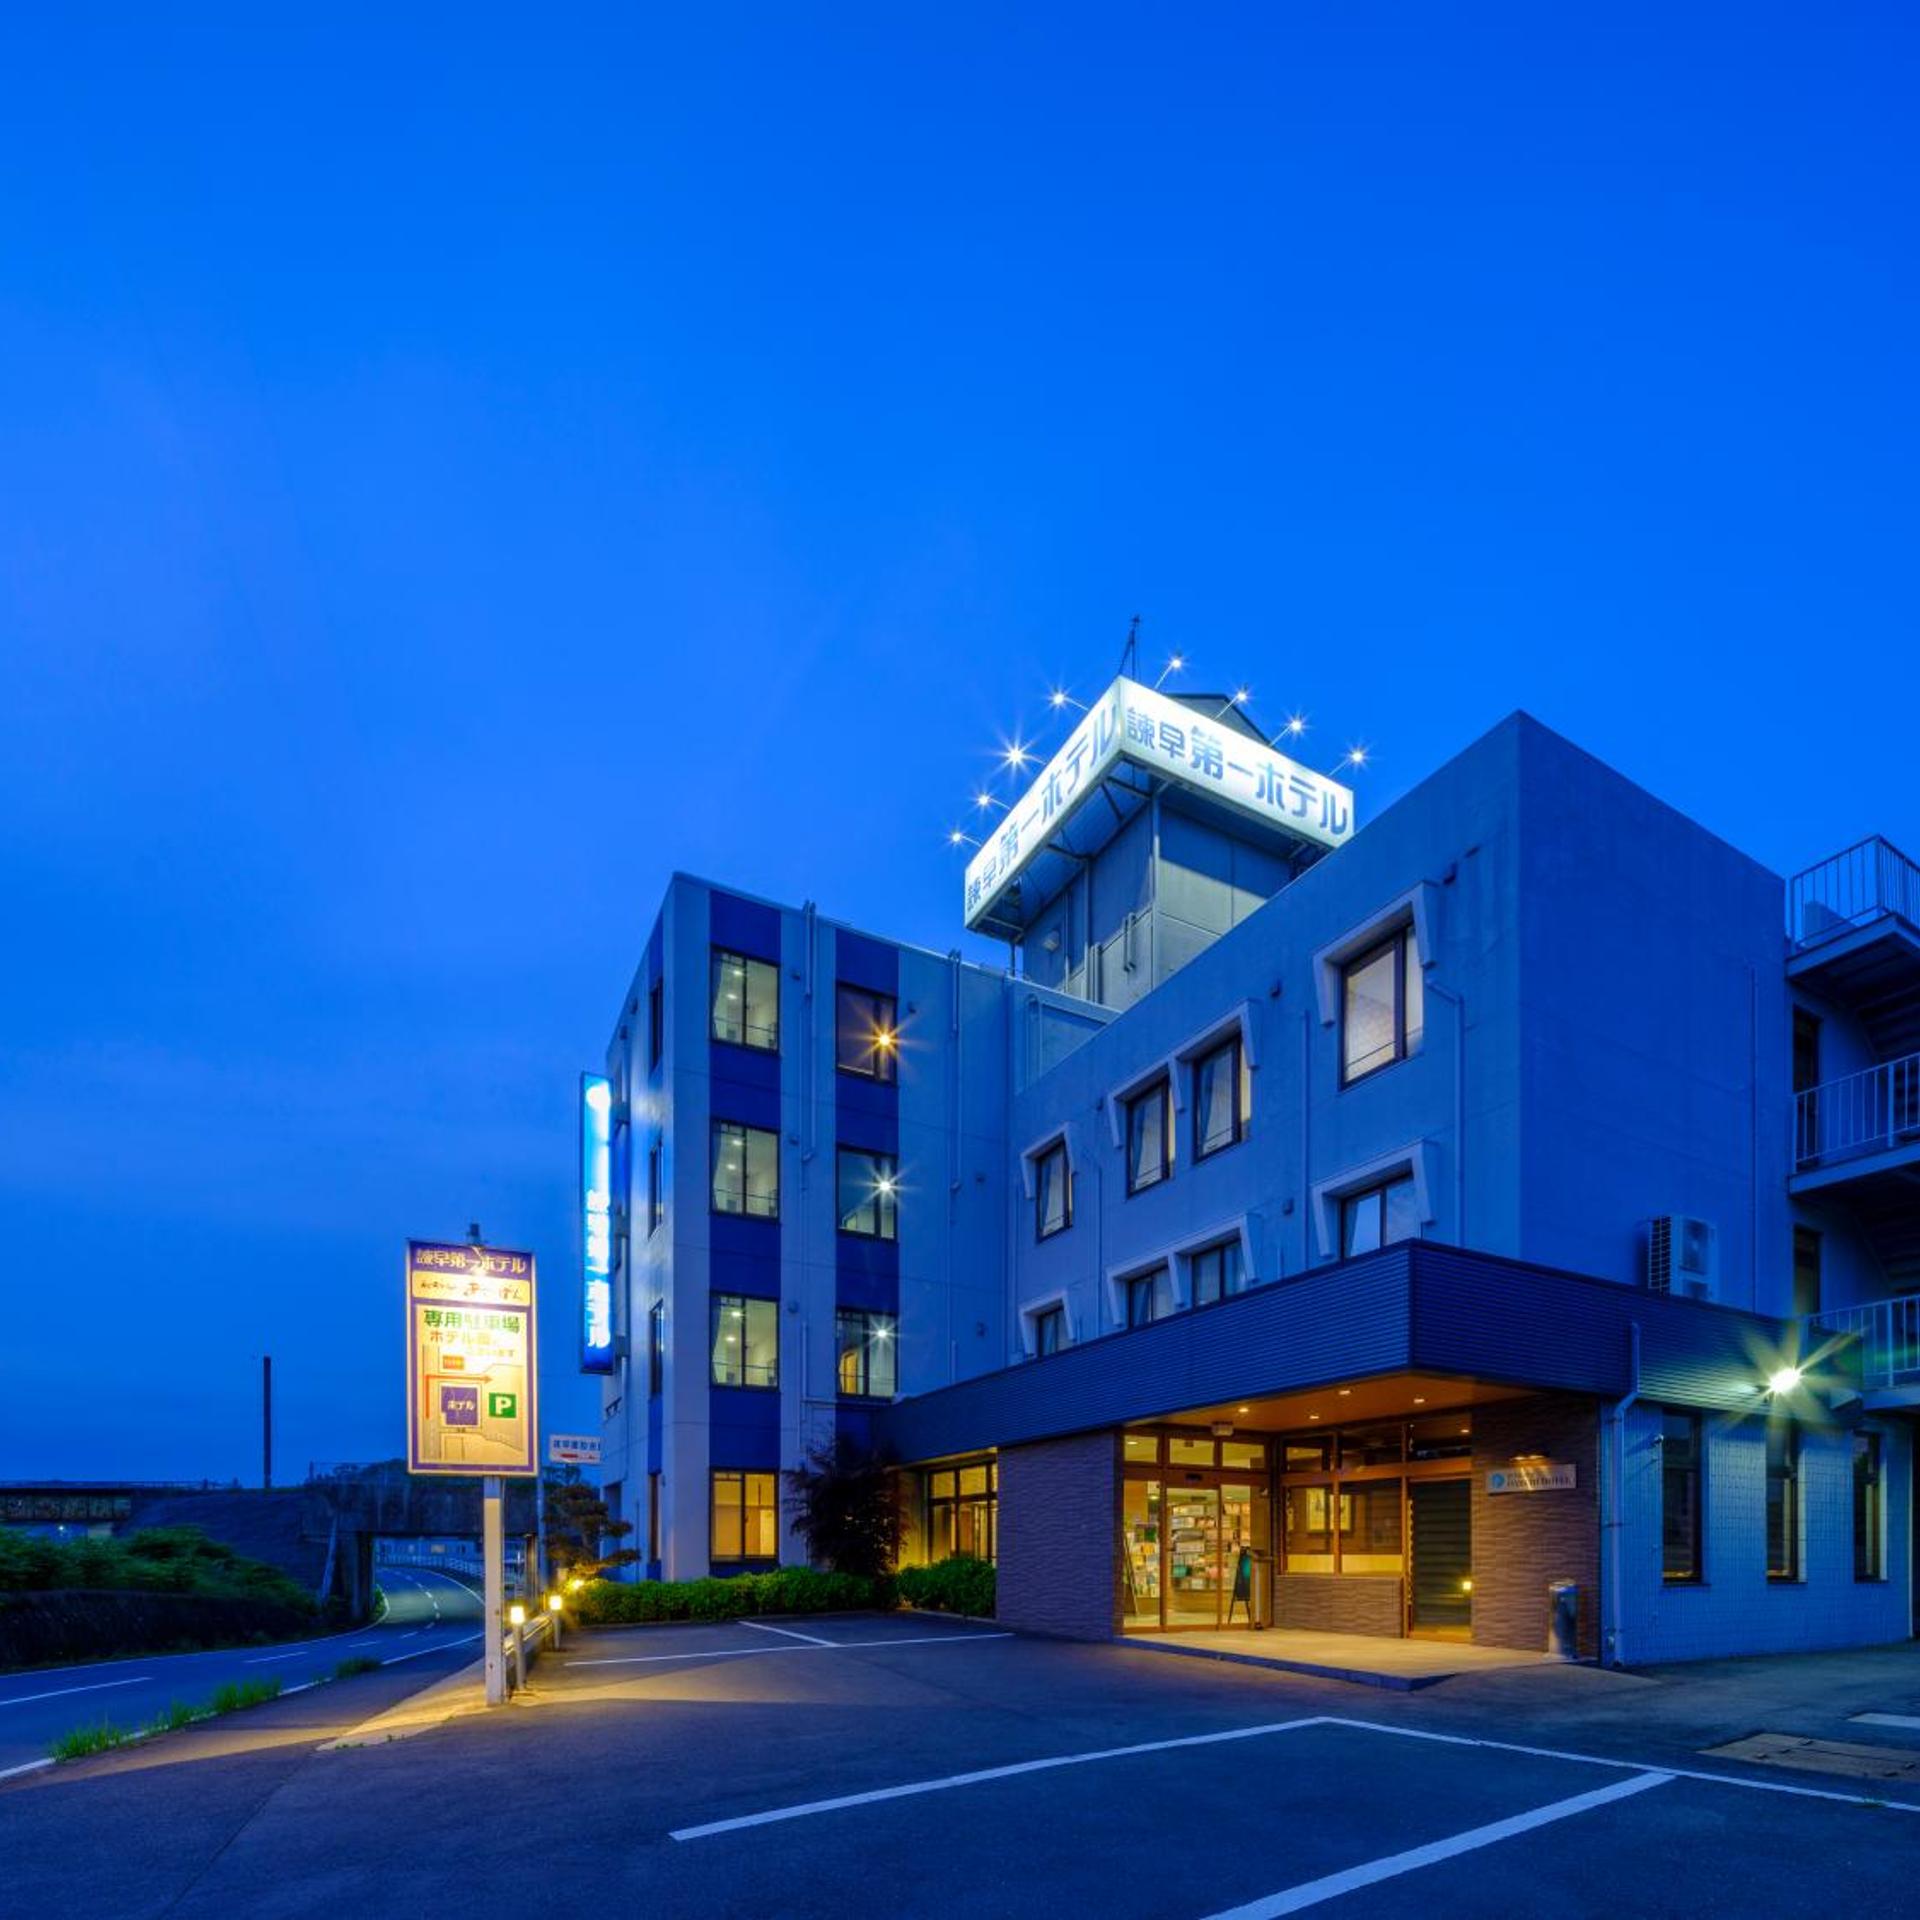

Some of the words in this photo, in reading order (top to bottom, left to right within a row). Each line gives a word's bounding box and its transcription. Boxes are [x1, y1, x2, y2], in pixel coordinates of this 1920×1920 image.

[966, 703, 1117, 911] 諫早第一ホテル
[1126, 706, 1349, 835] 諫早第一ホテル
[448, 1399, 474, 1411] ホテル
[496, 1396, 512, 1415] P
